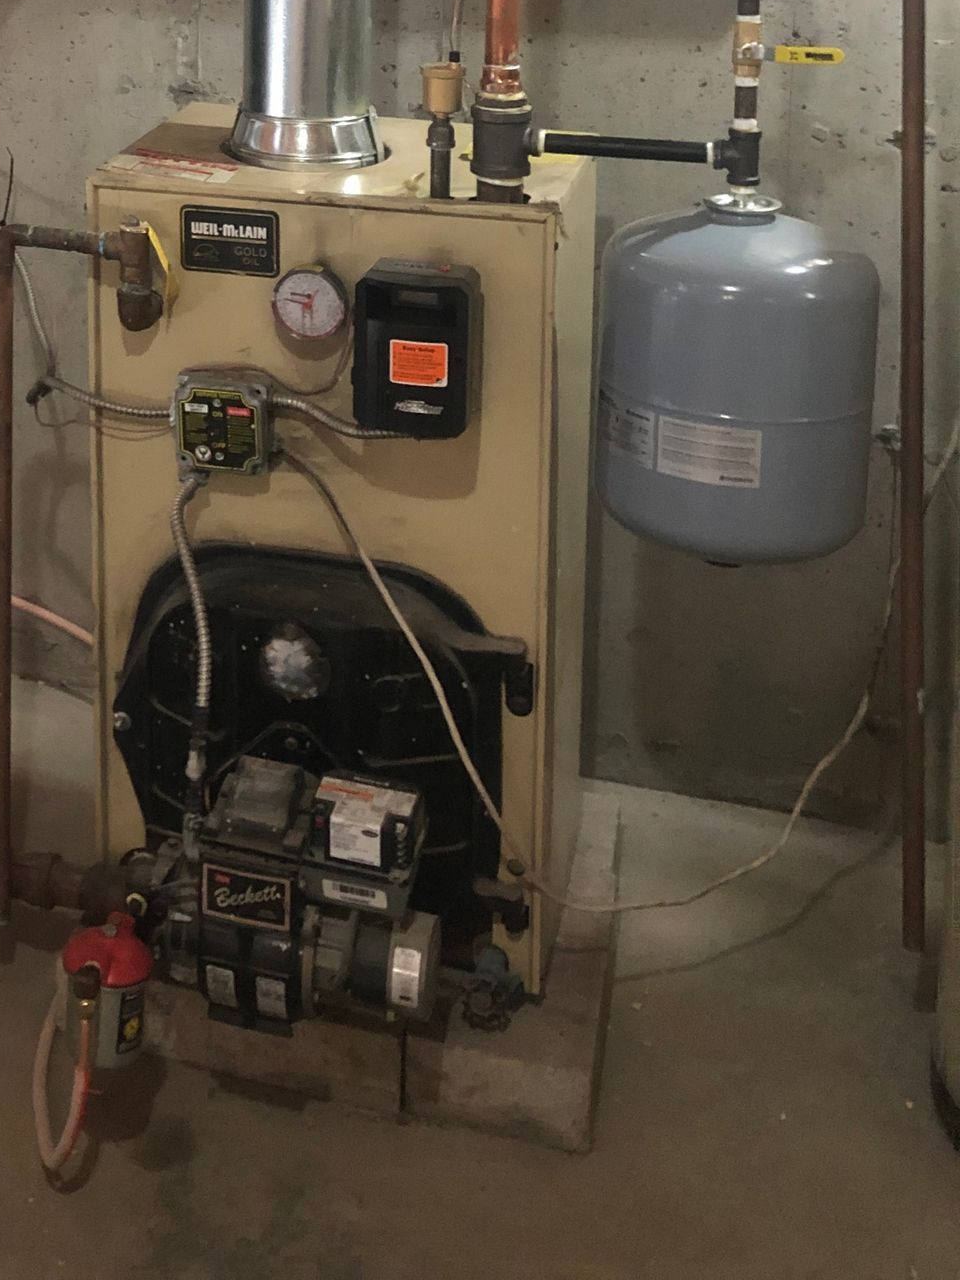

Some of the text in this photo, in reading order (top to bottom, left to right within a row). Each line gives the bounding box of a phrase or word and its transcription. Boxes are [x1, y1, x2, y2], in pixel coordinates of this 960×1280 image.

[234, 246, 267, 258] GOLD
[242, 258, 260, 266] OIL
[214, 884, 278, 908] Beckett
